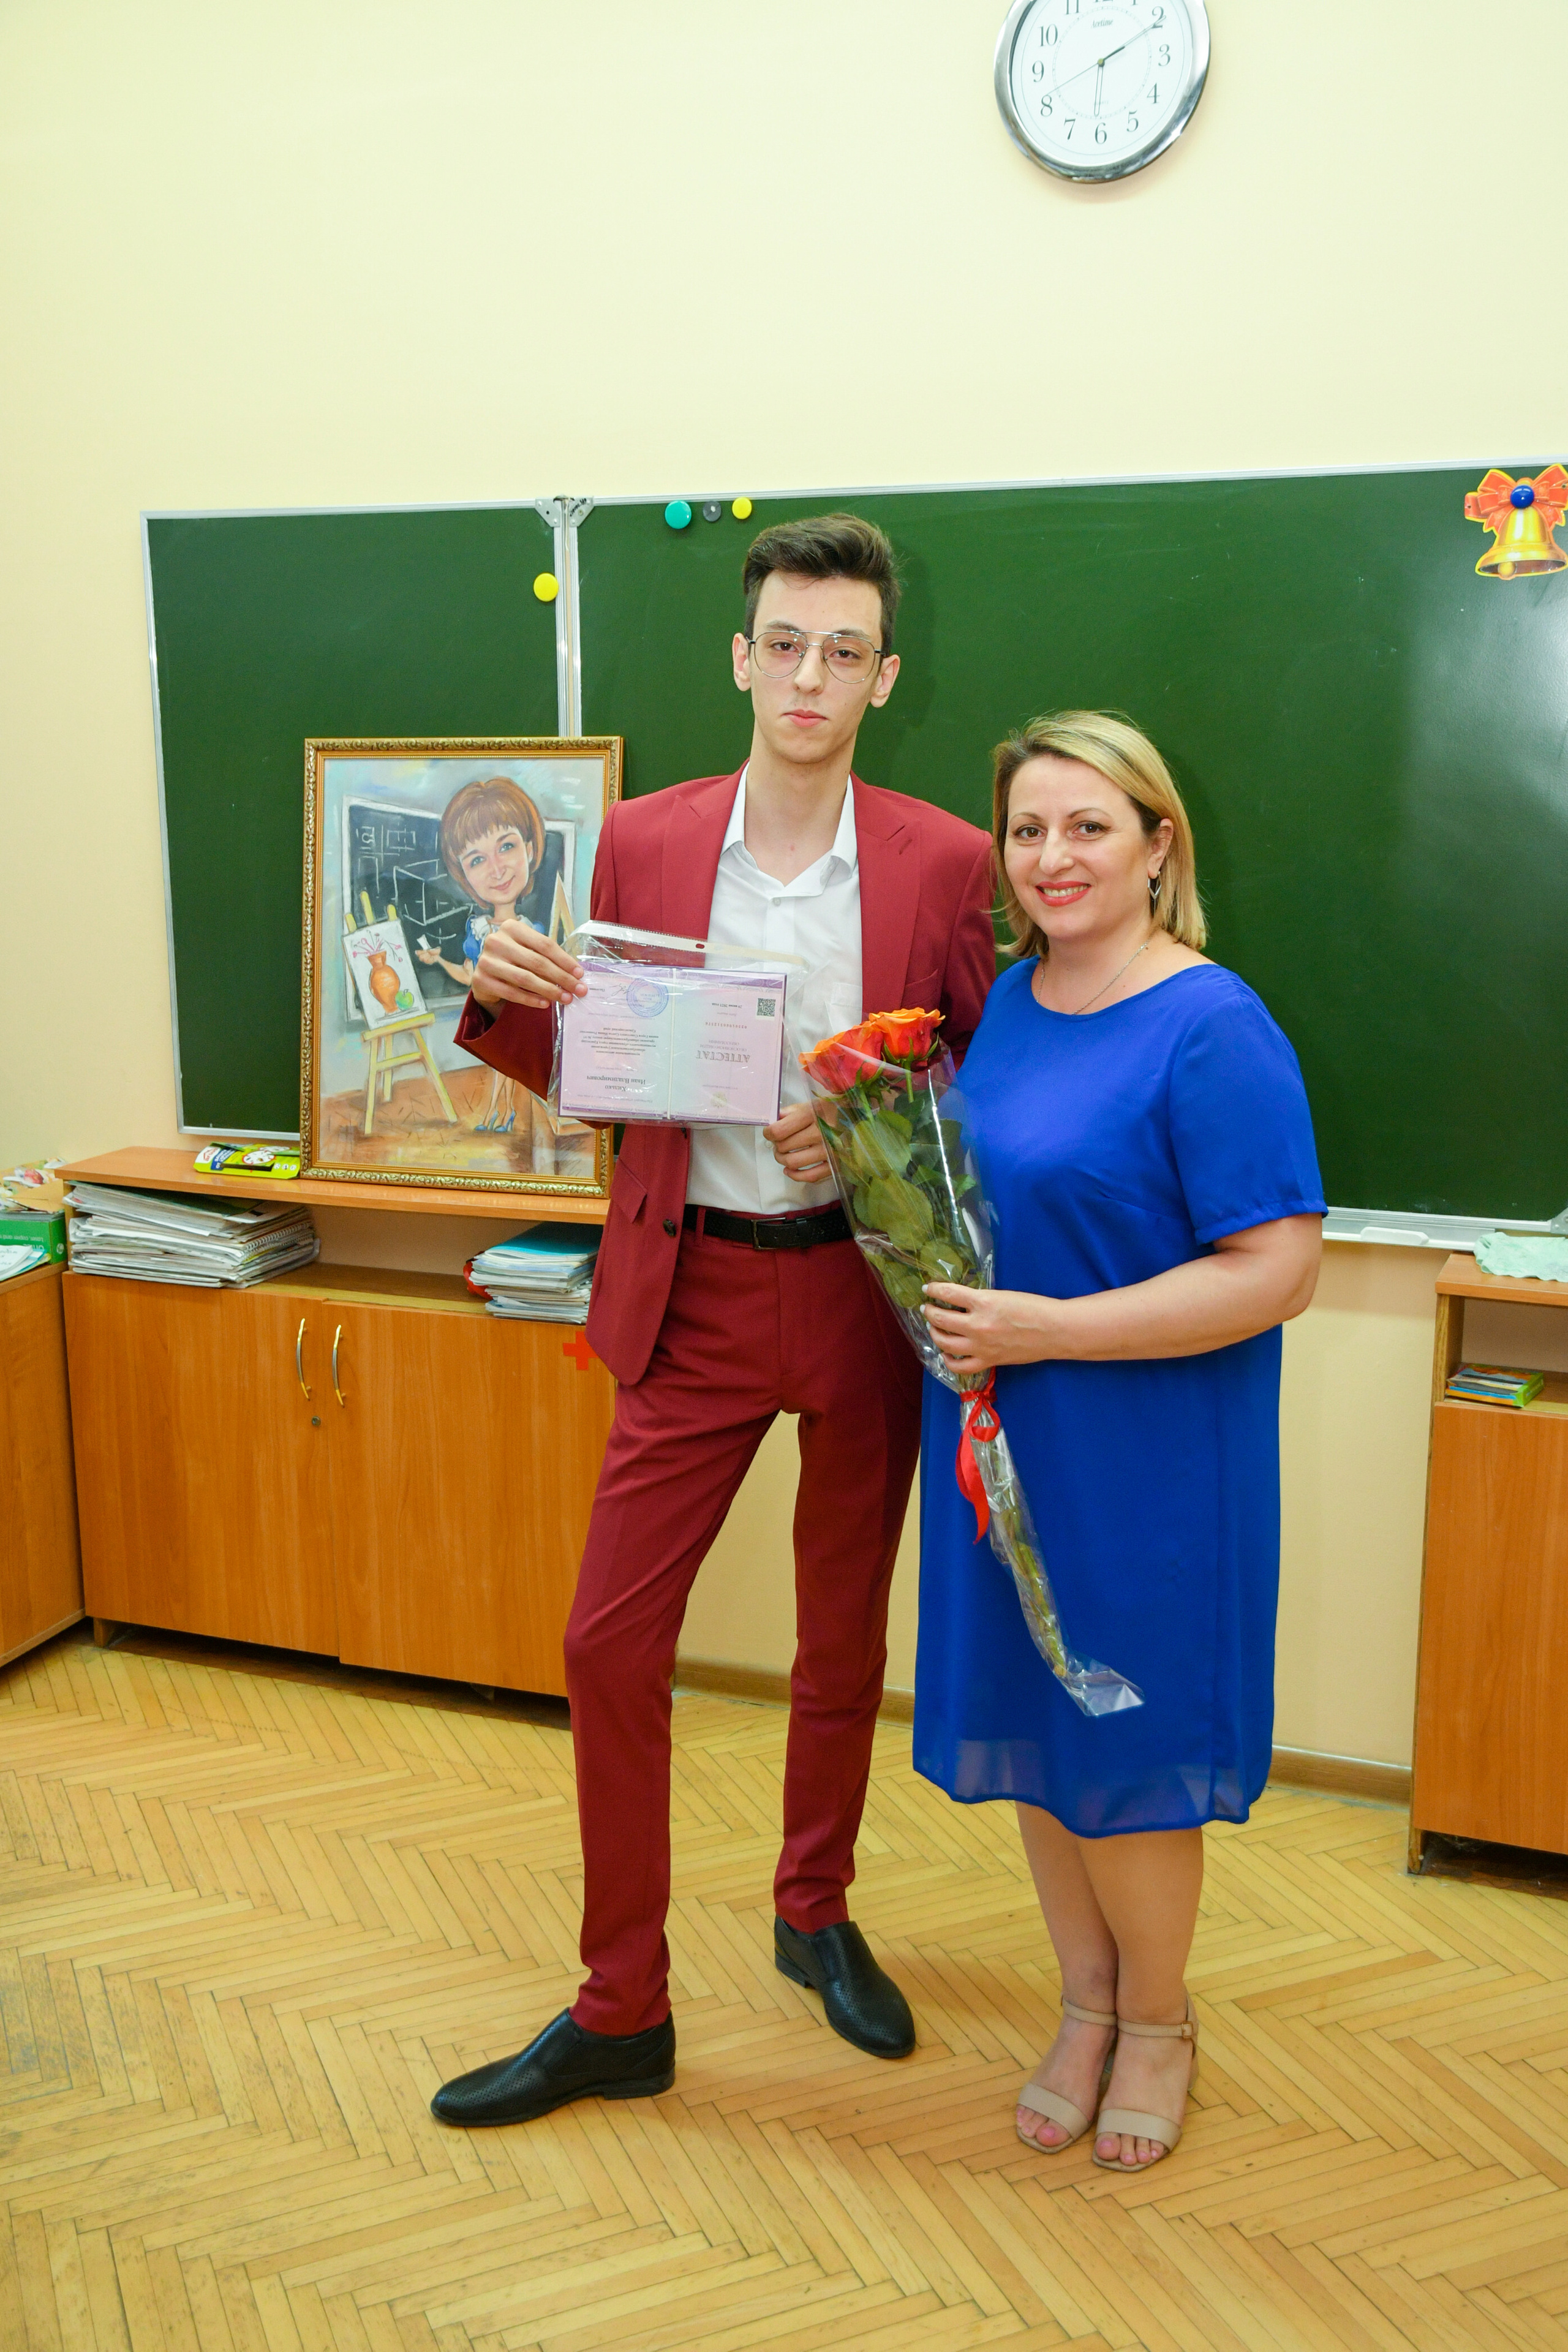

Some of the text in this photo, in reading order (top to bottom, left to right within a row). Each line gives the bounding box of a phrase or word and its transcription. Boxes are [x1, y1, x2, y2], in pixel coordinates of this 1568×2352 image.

[1152, 6, 1164, 29] 2
[1039, 24, 1058, 47] 10
[1158, 44, 1170, 67] 3
[1032, 61, 1044, 83] 9
[1147, 83, 1160, 104] 4
[1041, 94, 1053, 116] 8
[1063, 118, 1076, 140] 7
[1126, 110, 1139, 132] 5
[1095, 123, 1107, 145] 6
[696, 1050, 750, 1063] АТТЕСТАТ
[587, 1075, 629, 1084] Владимирович
